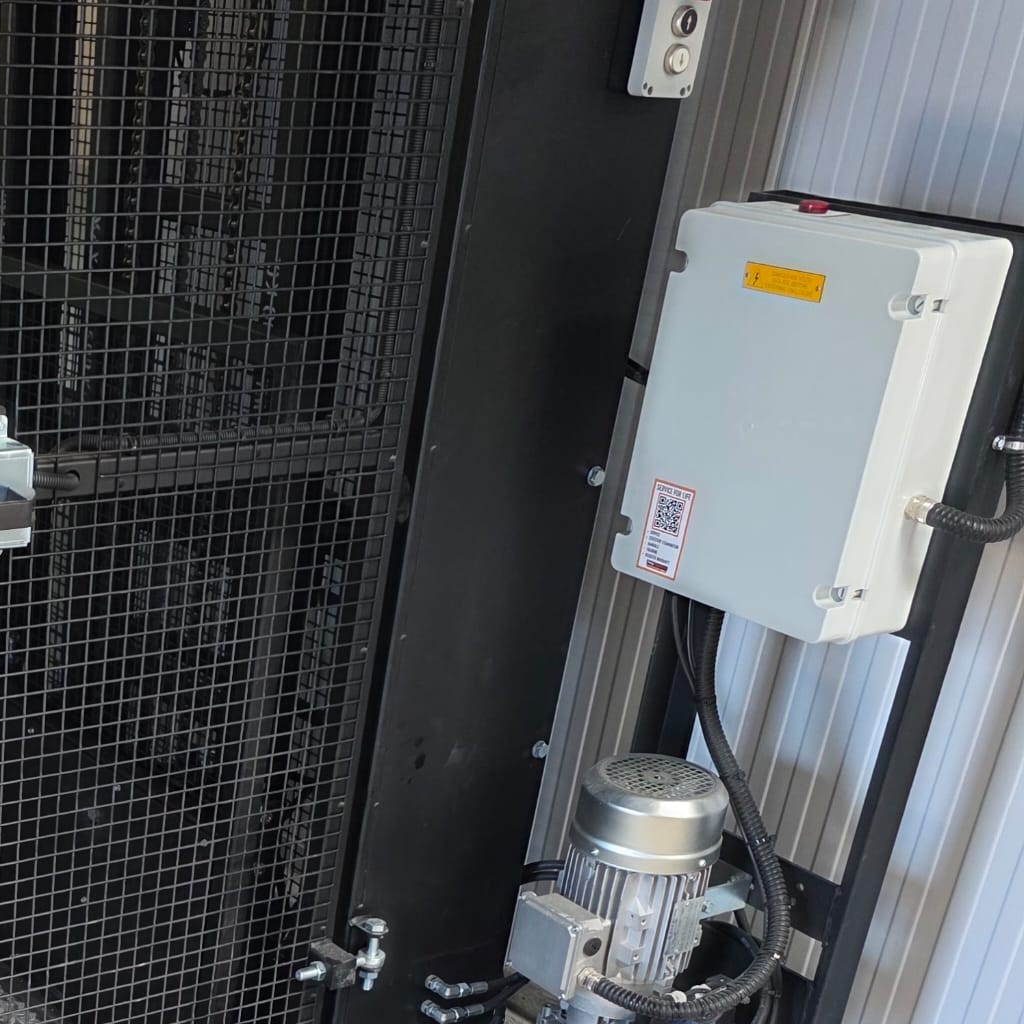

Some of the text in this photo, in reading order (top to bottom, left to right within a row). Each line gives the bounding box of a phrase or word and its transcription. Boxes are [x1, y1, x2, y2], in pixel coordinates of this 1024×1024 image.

[657, 484, 691, 501] SERVICE FOR LIFE
